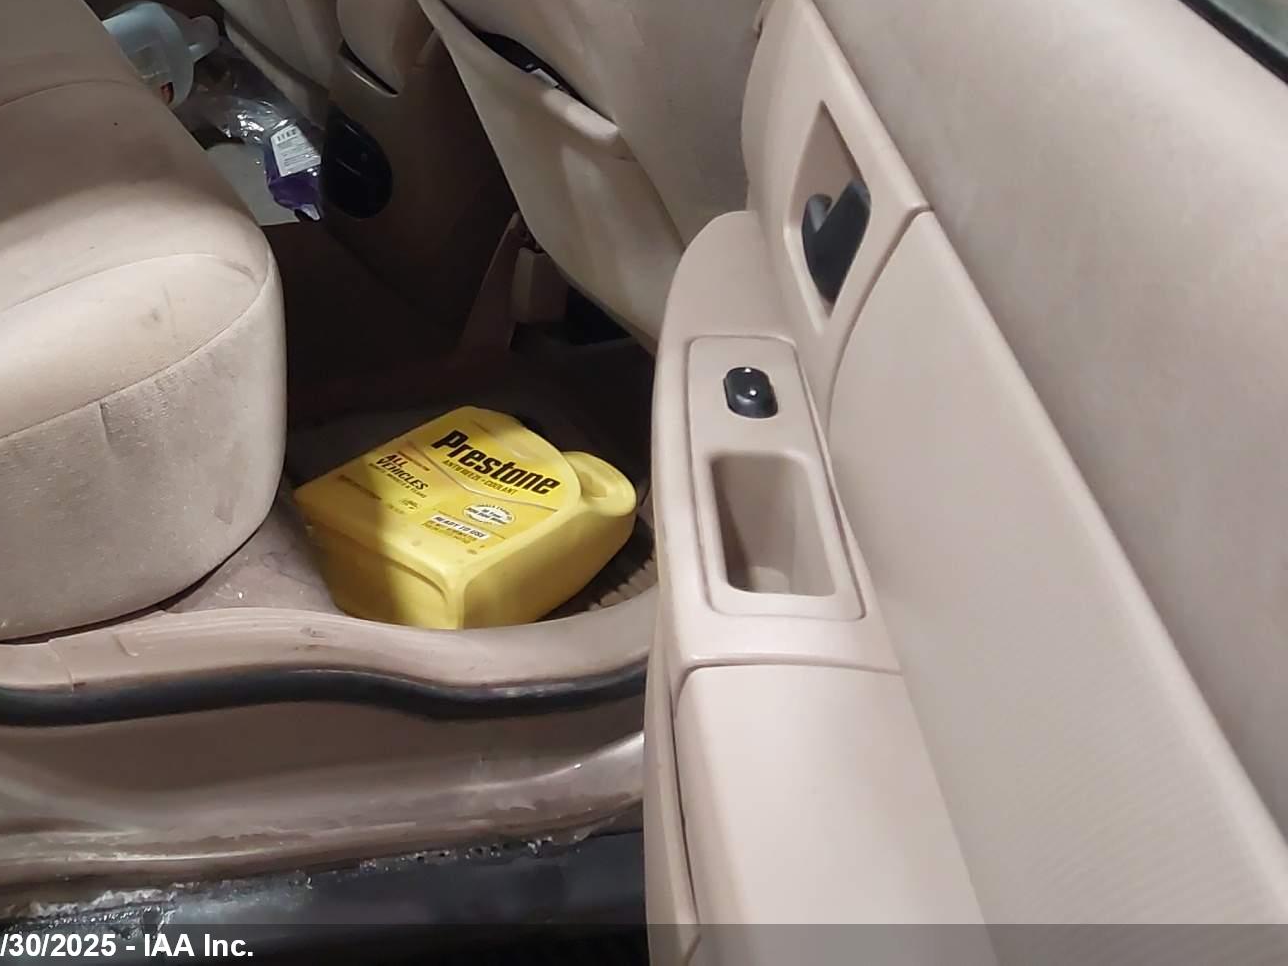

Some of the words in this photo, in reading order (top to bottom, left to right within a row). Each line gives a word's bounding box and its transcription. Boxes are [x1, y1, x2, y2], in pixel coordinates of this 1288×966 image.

[383, 453, 408, 468] ALL
[431, 430, 560, 495] Prestone
[376, 458, 429, 490] VEHICLES
[483, 479, 519, 496] COOLANT
